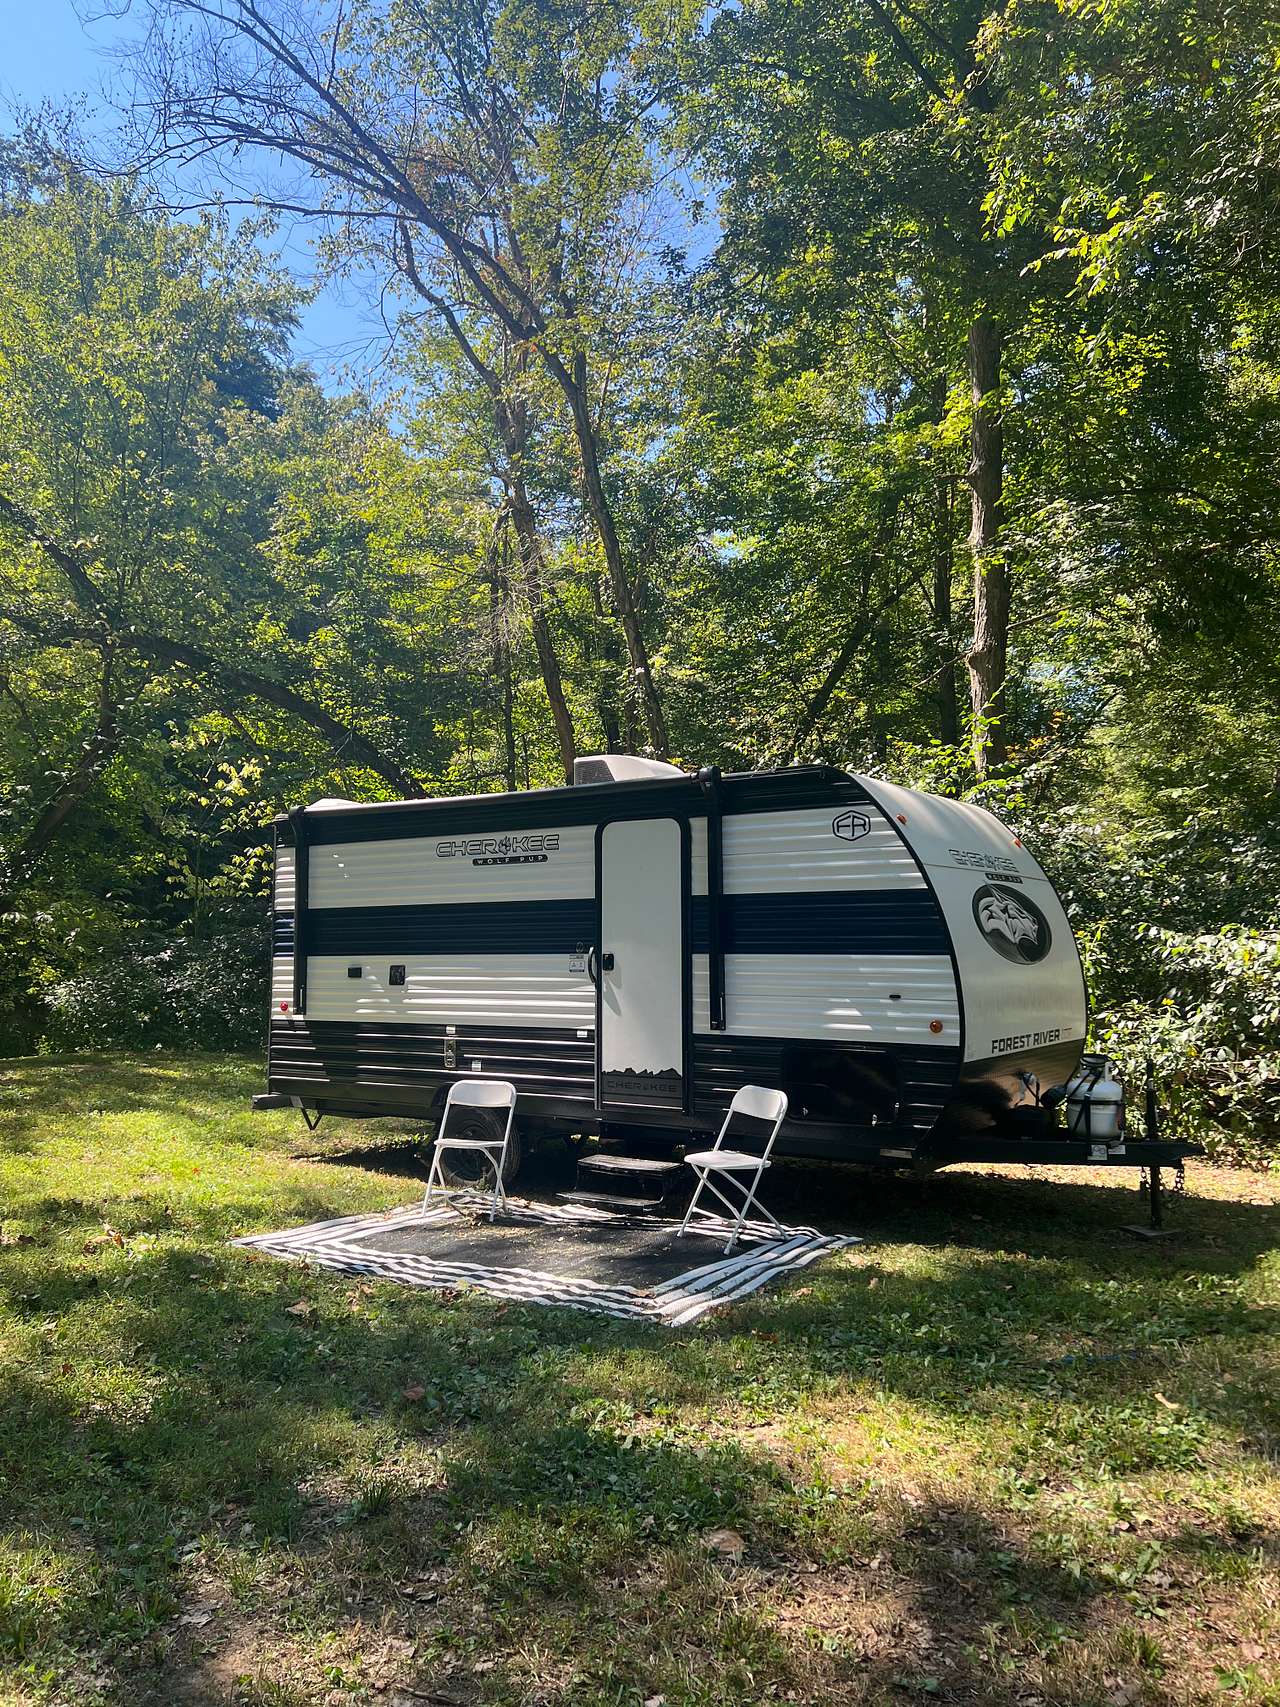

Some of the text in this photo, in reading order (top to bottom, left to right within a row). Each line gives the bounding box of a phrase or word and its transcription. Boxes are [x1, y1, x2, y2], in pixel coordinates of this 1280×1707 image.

[436, 834, 559, 857] CHEROKEE
[477, 857, 510, 865] WOLF
[991, 1034, 1032, 1054] FOREST
[1033, 1028, 1060, 1046] RIVER
